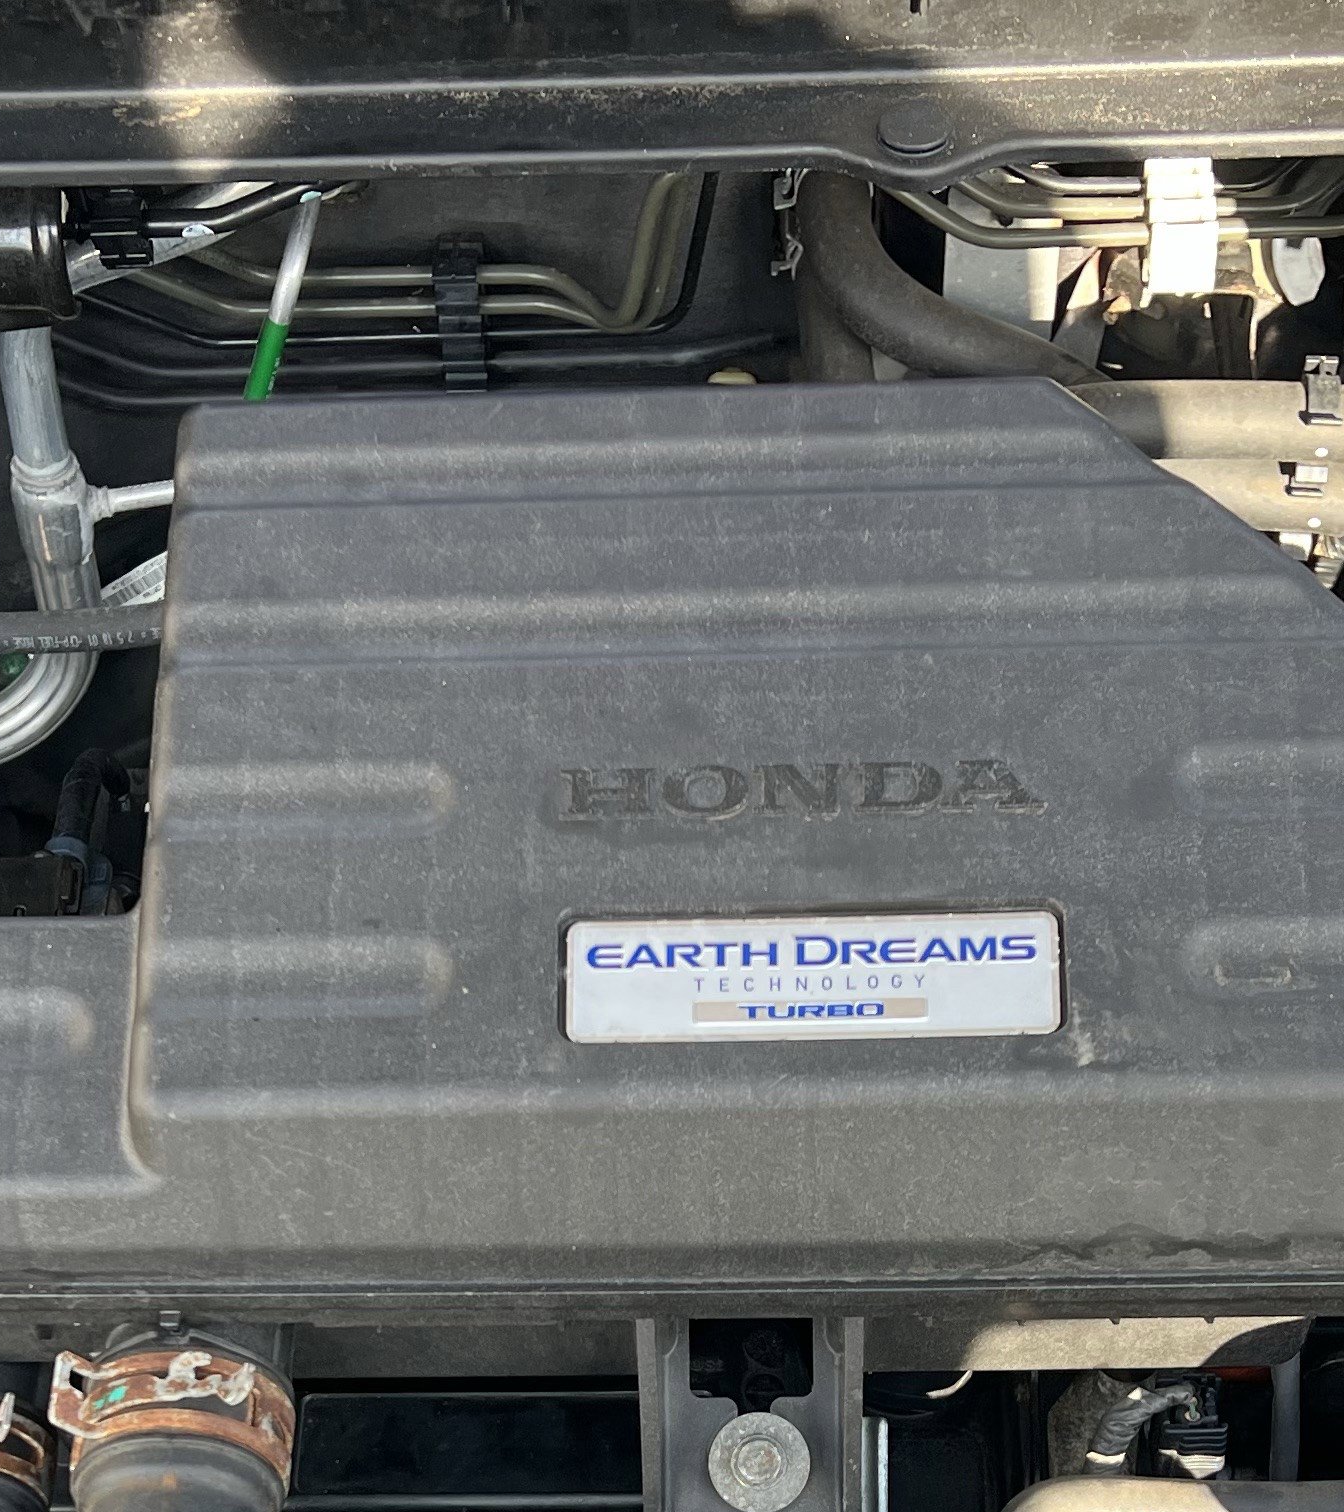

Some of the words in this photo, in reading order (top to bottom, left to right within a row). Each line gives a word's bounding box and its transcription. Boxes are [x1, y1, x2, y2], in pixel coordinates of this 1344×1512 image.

[558, 758, 1048, 821] HONDA
[586, 942, 779, 970] EARTH
[793, 933, 1038, 969] DREAMS
[693, 973, 928, 993] TECHNOLOGY
[736, 1001, 885, 1020] TURBO
